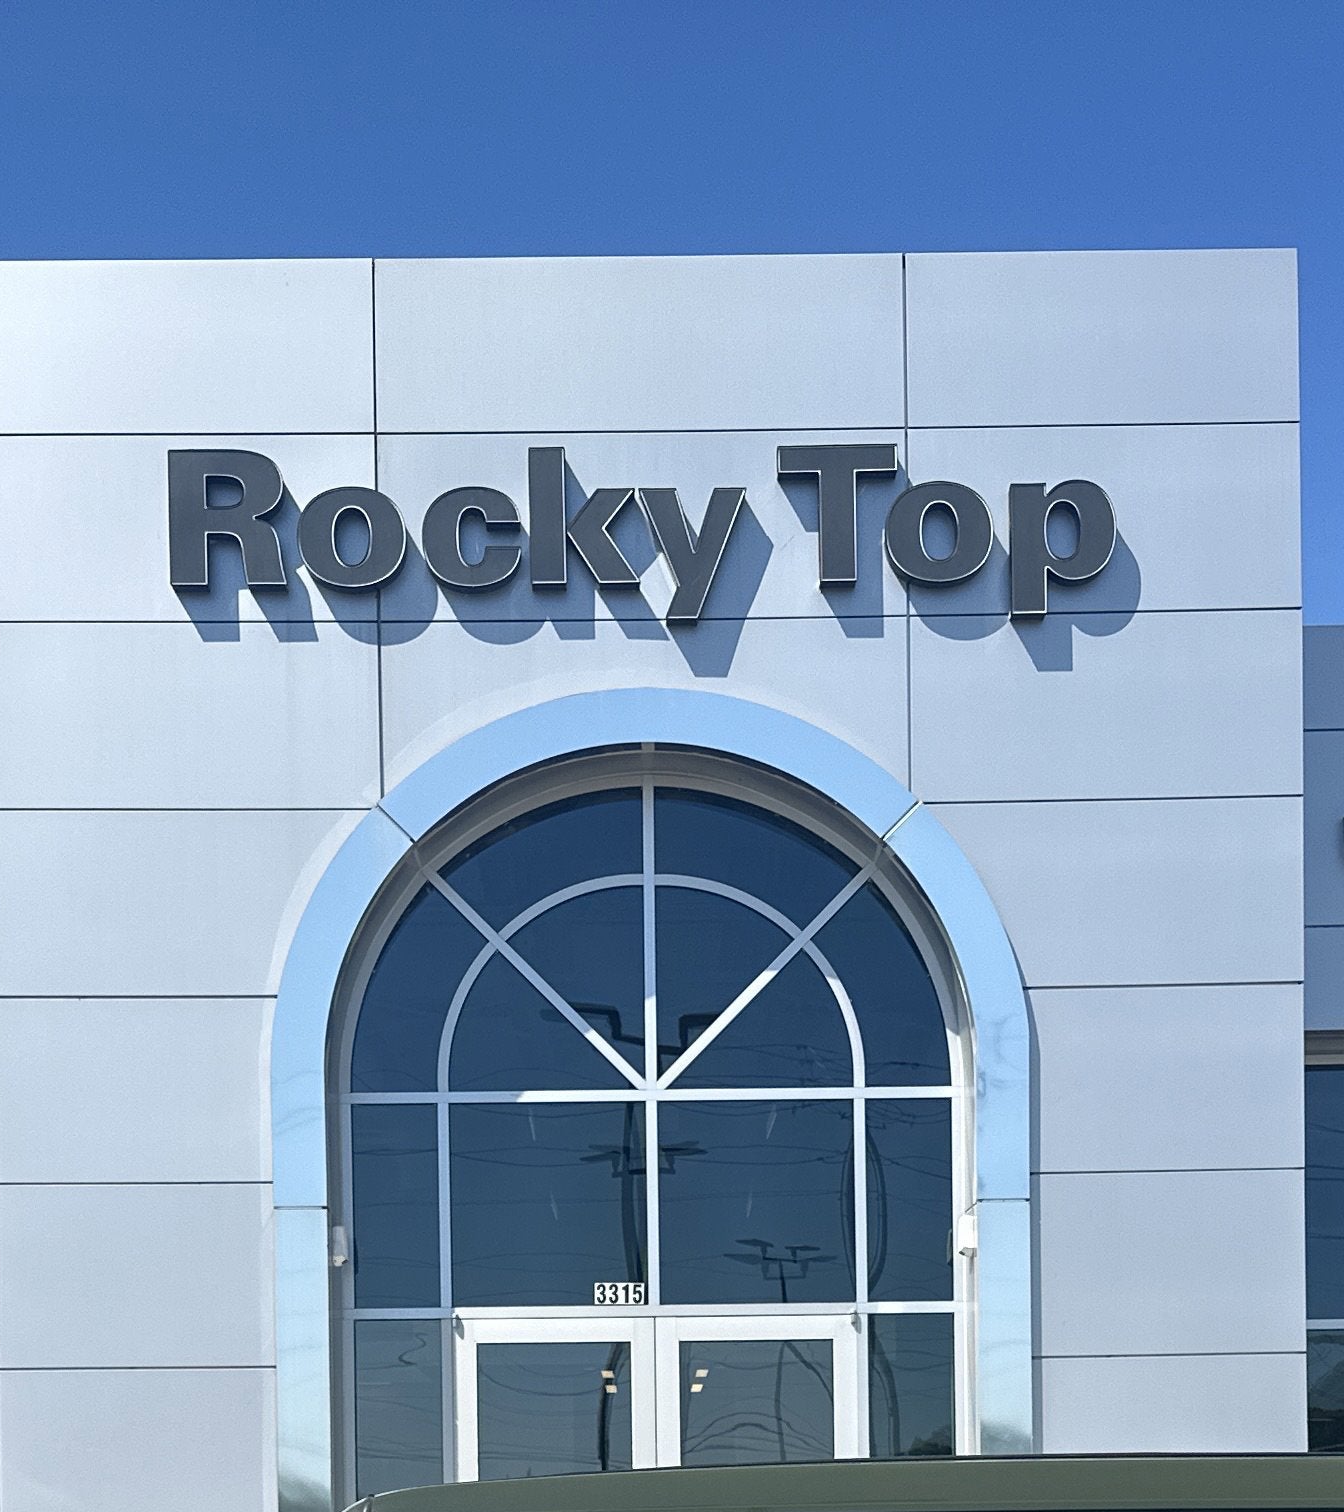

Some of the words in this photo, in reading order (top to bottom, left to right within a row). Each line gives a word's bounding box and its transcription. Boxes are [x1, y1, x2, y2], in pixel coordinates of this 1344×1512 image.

[168, 447, 746, 626] Rocky
[776, 444, 1117, 620] Top
[596, 1283, 643, 1304] 3315
